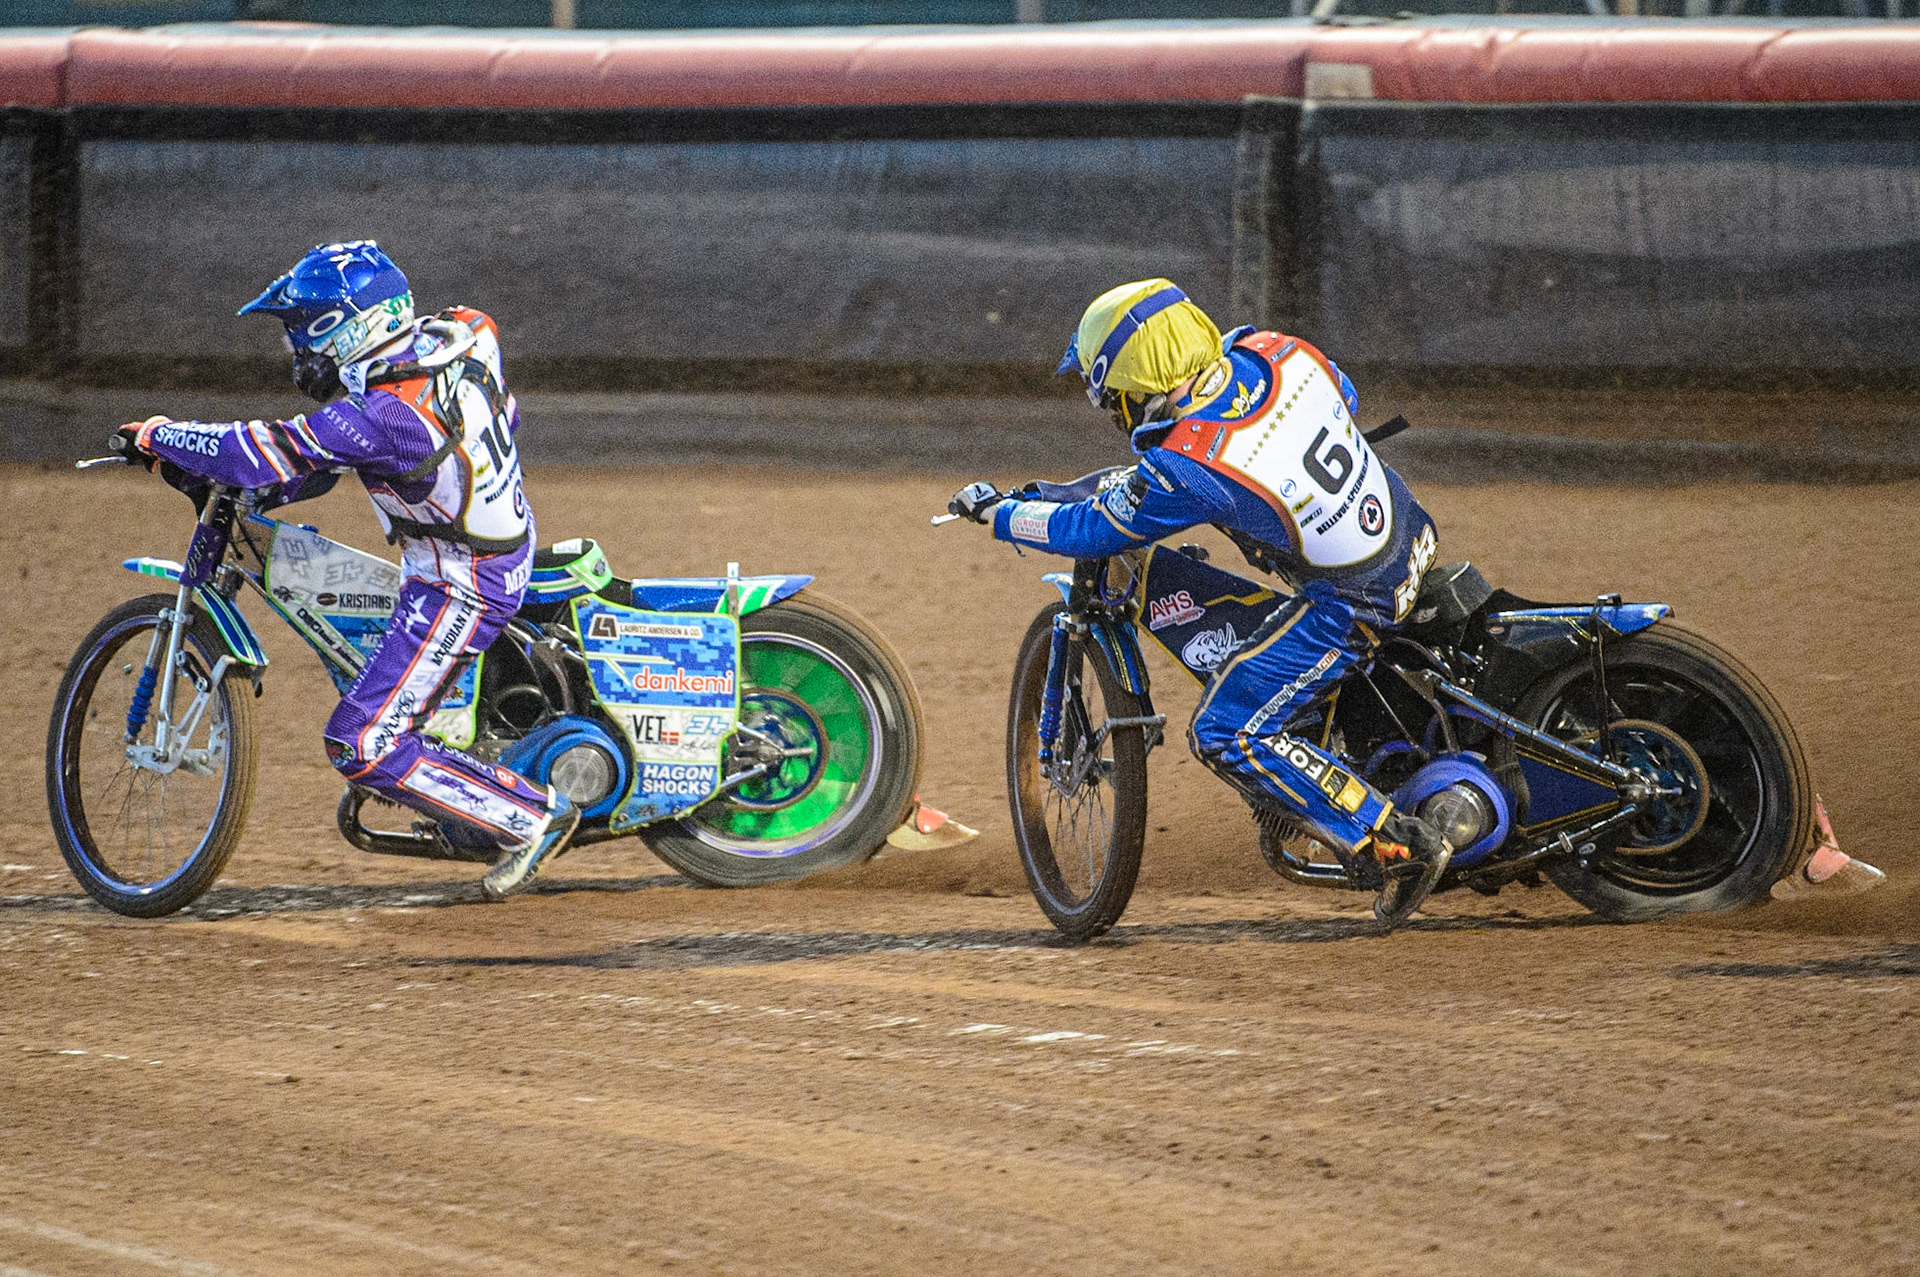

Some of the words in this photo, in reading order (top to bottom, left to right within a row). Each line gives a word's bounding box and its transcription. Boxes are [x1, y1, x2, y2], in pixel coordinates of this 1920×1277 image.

[155, 426, 220, 457] SHOCKS
[479, 407, 513, 475] 10
[1303, 425, 1353, 495] 6
[1016, 517, 1047, 529] GROUP
[338, 592, 392, 610] KRISTIANS
[1151, 592, 1193, 621] AHS
[431, 613, 468, 667] MERIDIAN
[634, 666, 734, 694] dankemi
[631, 714, 667, 742] VET
[643, 764, 715, 781] HAGON
[642, 779, 712, 796] SHOCKS
